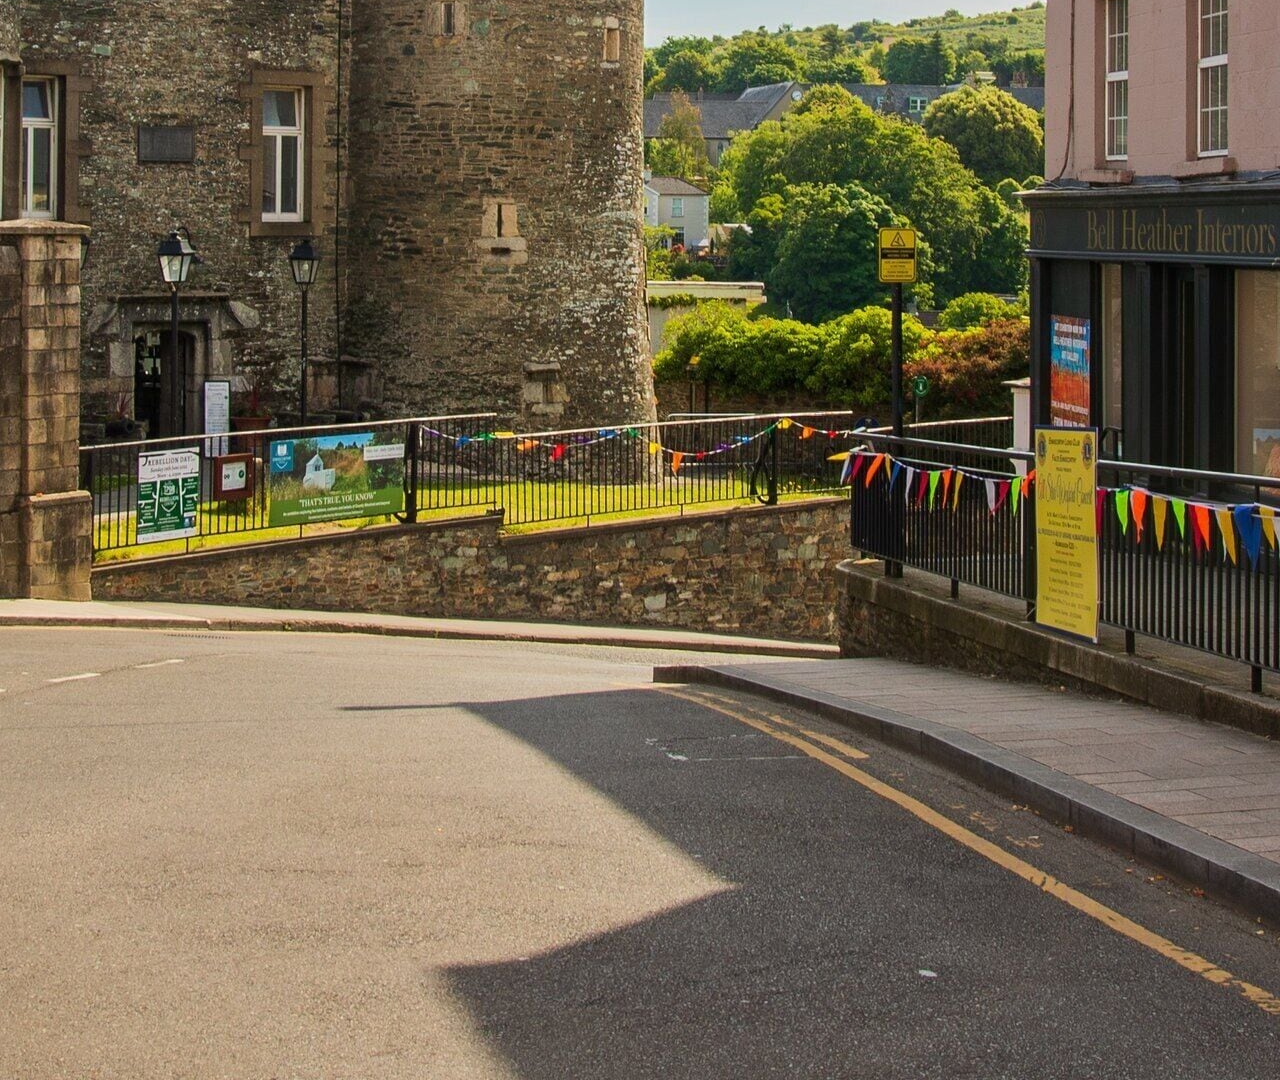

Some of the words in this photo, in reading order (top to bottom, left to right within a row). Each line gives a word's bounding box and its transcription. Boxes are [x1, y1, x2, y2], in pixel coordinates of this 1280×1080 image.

[1087, 209, 1115, 251] Bell
[1121, 209, 1192, 253] Heather
[1195, 209, 1277, 254] Interiors
[148, 456, 179, 466] REBELLION
[341, 494, 355, 504] YOU
